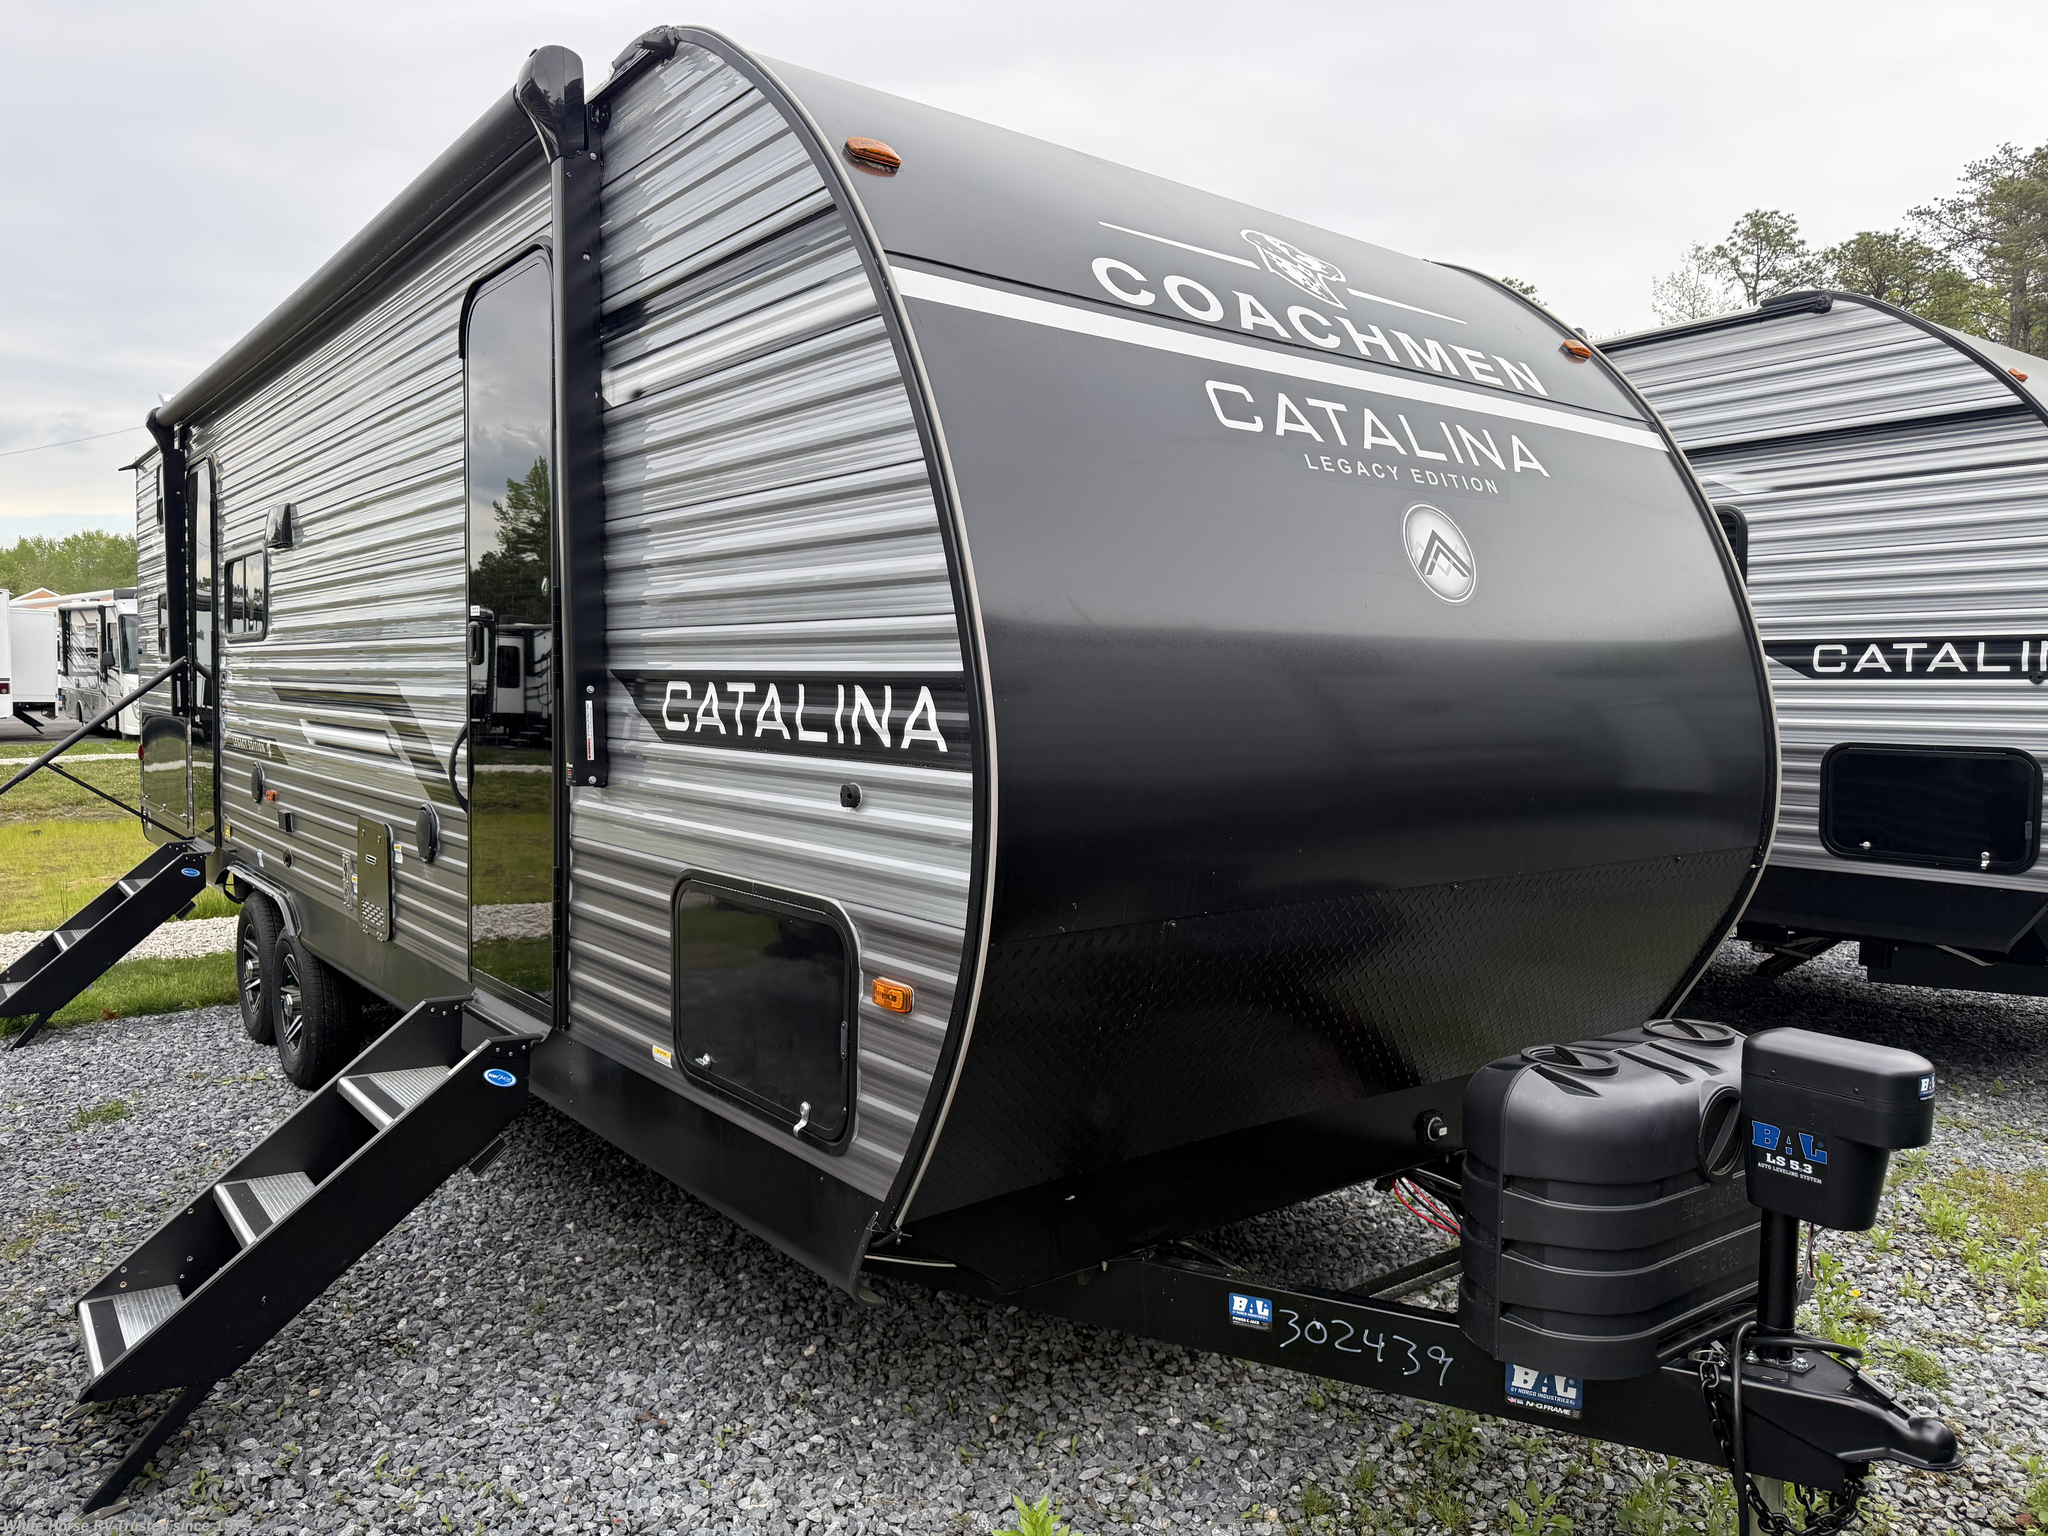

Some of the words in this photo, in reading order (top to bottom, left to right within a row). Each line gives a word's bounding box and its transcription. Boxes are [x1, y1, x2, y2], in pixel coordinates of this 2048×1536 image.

[1091, 257, 1549, 397] COACHMEN
[1205, 380, 1551, 477] CATALINA
[1304, 453, 1399, 481] LEGACY
[1410, 468, 1499, 494] EDITION
[662, 680, 949, 753] CATALINA
[1752, 1120, 1828, 1165] BAL
[1757, 1161, 1772, 1170] AUTO
[1773, 1166, 1799, 1178] LEVELING
[1800, 1173, 1822, 1185] SYSTEM
[1766, 1152, 1786, 1167] LS
[1789, 1159, 1813, 1175] 5.3
[1232, 1295, 1270, 1317] BAL
[1278, 1309, 1454, 1387] 302439
[1512, 1364, 1577, 1399] BAL
[1518, 1388, 1537, 1397] NORCO
[1537, 1392, 1570, 1404] INDUSTRIES
[1543, 1405, 1571, 1415] FRAME
